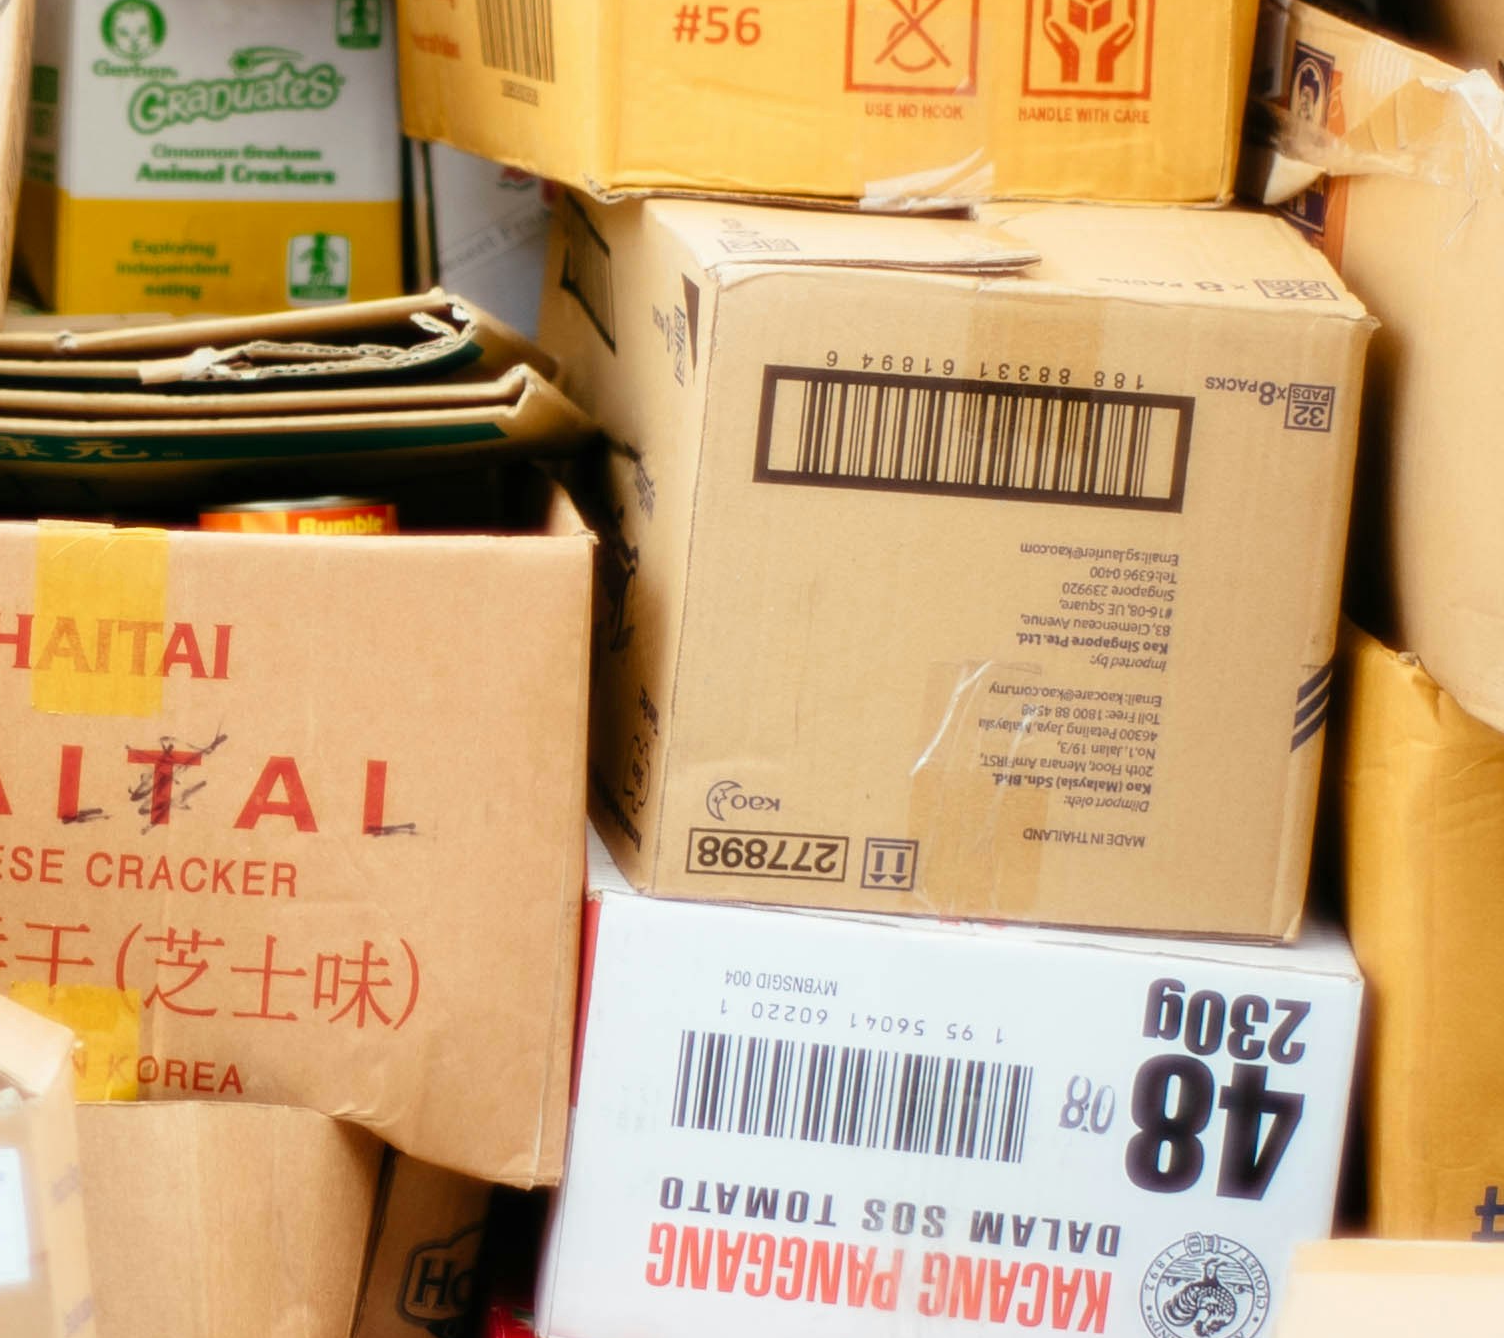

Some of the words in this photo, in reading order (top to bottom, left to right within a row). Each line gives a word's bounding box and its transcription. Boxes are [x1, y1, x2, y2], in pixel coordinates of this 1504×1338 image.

[672, 4, 763, 48] #56
[226, 163, 336, 189] Crackers
[1111, 584, 1176, 602] Singapore
[697, 834, 839, 874] 277898
[1023, 828, 1087, 844] THAILAND
[84, 850, 298, 901] CRACKER
[1142, 977, 1313, 1062] 230g
[1124, 1054, 1307, 1202] 48
[658, 1174, 840, 1229] TOMATO
[970, 1207, 1122, 1259] DALAM
[644, 1220, 901, 1306] PANGGANG
[917, 1249, 1114, 1335] KACANG
